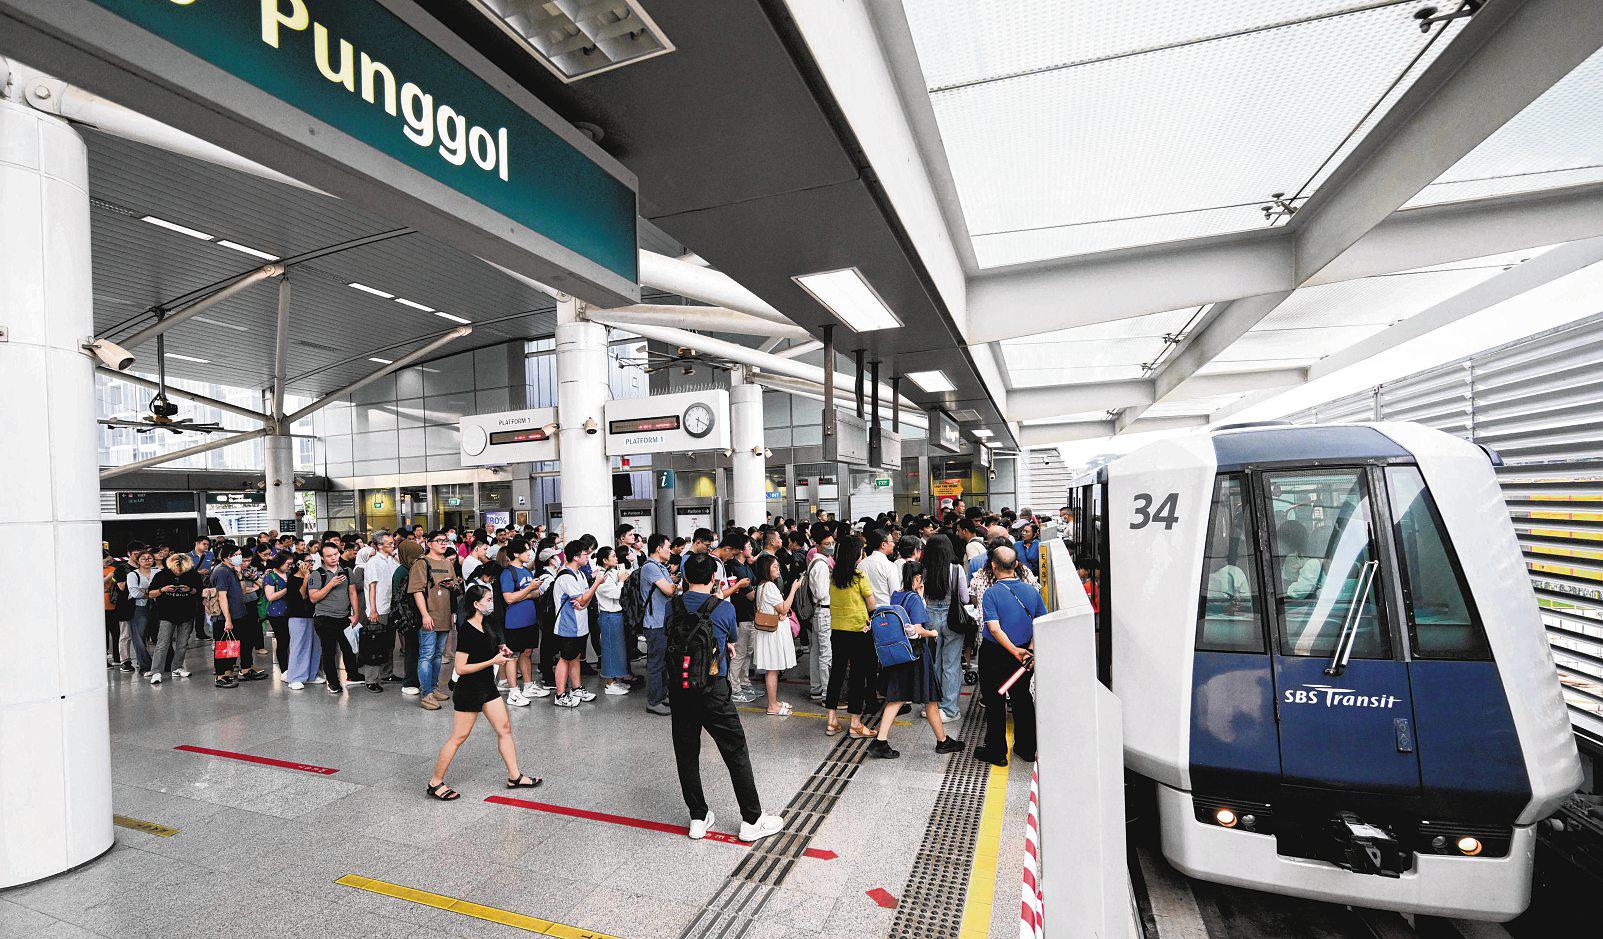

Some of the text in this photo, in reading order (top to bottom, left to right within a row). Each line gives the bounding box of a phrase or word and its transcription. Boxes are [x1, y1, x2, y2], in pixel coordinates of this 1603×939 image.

[261, 0, 508, 182] Punggol
[498, 418, 527, 426] PLATFORM
[625, 435, 658, 445] PLATFORM
[1129, 492, 1180, 531] 34
[1284, 687, 1402, 709] SBS Transit
